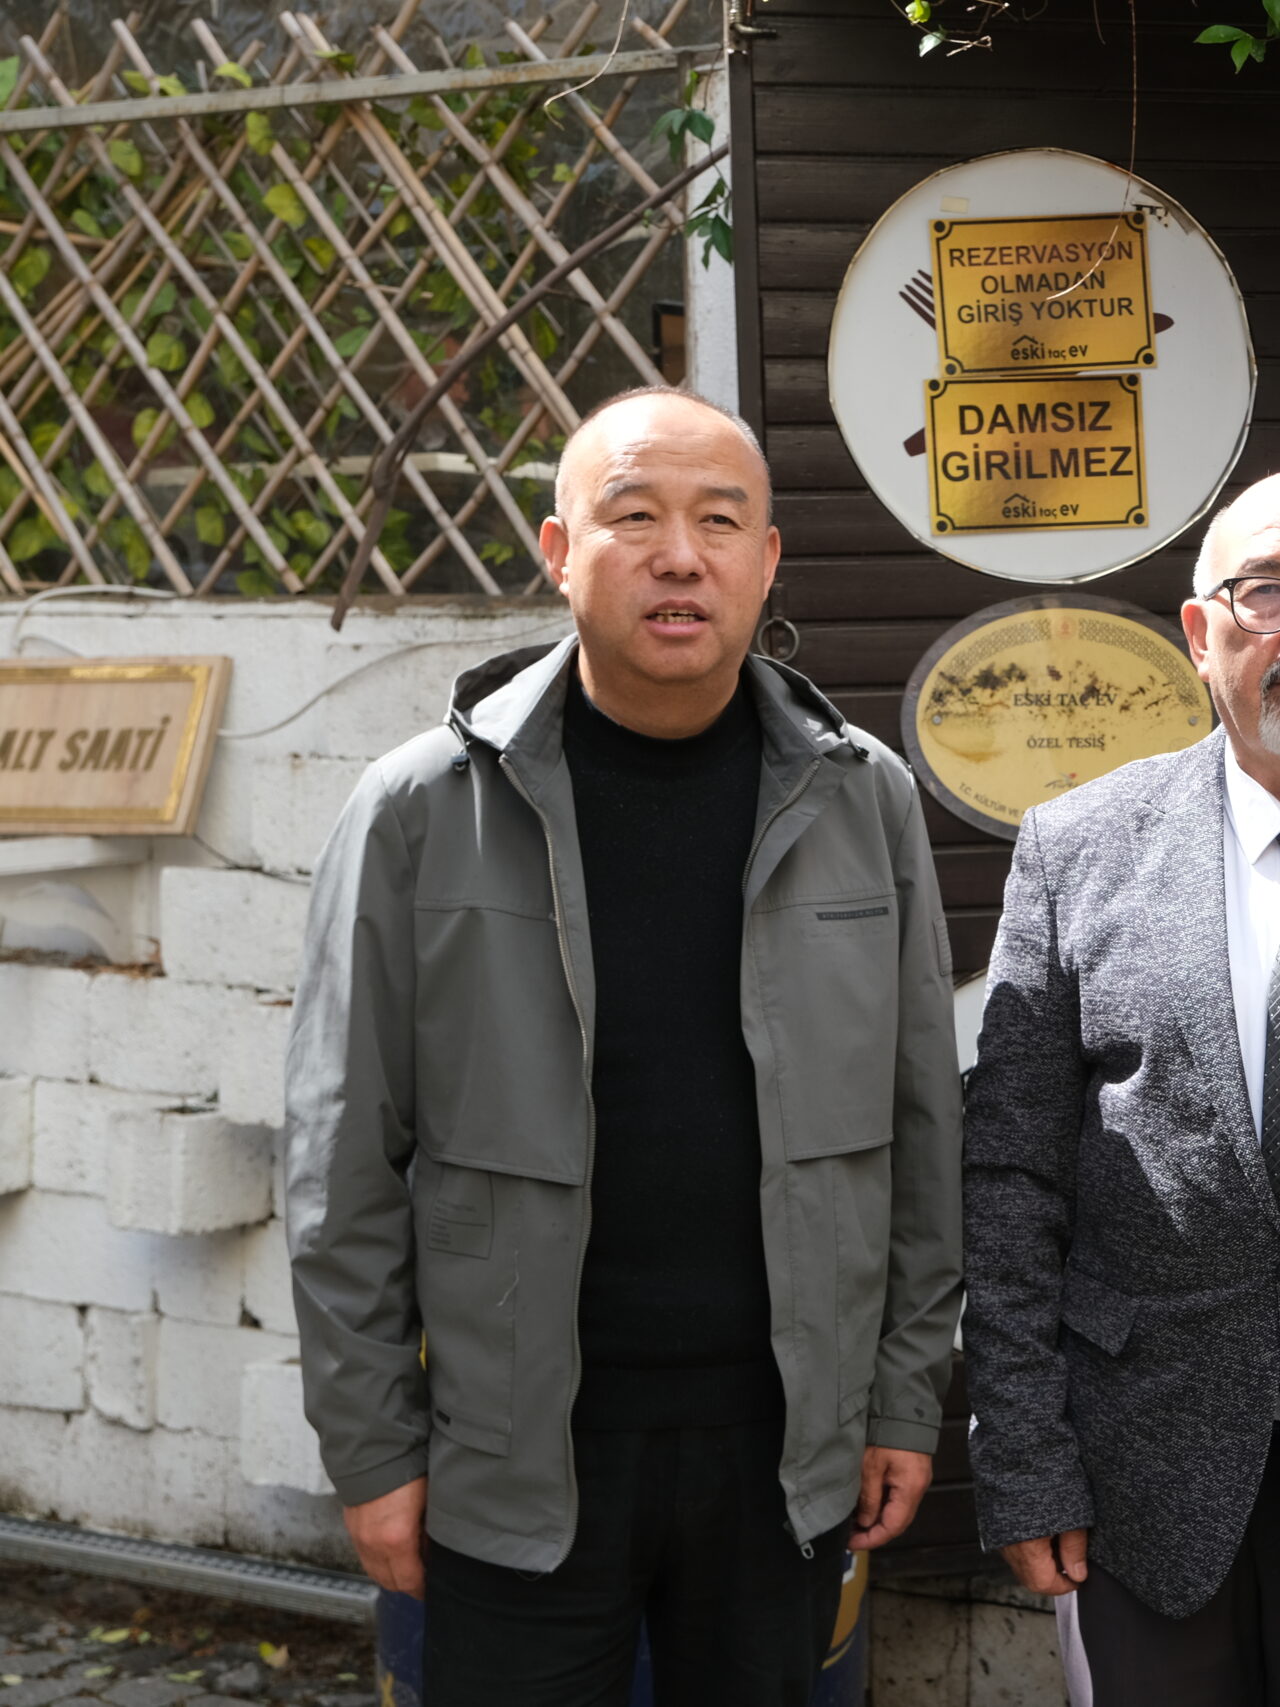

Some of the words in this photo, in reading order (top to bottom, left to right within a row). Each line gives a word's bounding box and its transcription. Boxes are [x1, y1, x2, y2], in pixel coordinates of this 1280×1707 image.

[949, 241, 1133, 267] REZERVASYON
[981, 271, 1106, 295] OLMADAN
[957, 298, 1023, 326] GİRİŞ
[1030, 297, 1135, 321] YOKTUR
[1010, 343, 1046, 361] eski
[1047, 348, 1066, 361] taç
[1068, 345, 1088, 358] ev
[958, 401, 1113, 435] DAMSIZ
[941, 441, 1134, 482] GİRİLMEZ
[1001, 501, 1036, 519] eski
[1039, 507, 1057, 519] taç
[1060, 503, 1079, 516] ev
[1095, 693, 1118, 707] EV
[58, 714, 172, 773] SAATİ
[1026, 734, 1062, 749] ÖZEL
